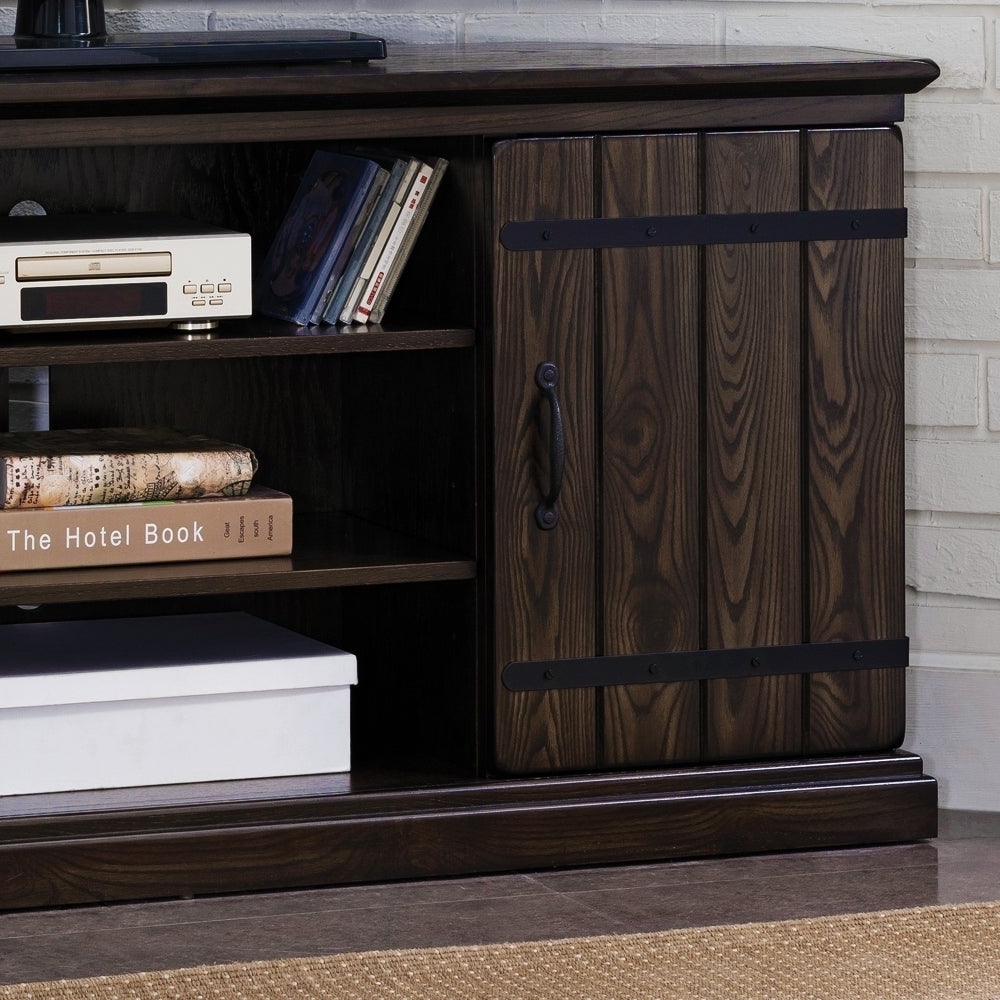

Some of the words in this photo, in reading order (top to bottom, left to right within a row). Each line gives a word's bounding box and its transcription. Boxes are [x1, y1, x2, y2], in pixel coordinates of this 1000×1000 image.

[6, 529, 51, 552] The
[66, 525, 130, 549] Hotel
[145, 521, 204, 545] Book
[238, 515, 246, 543] Escapes
